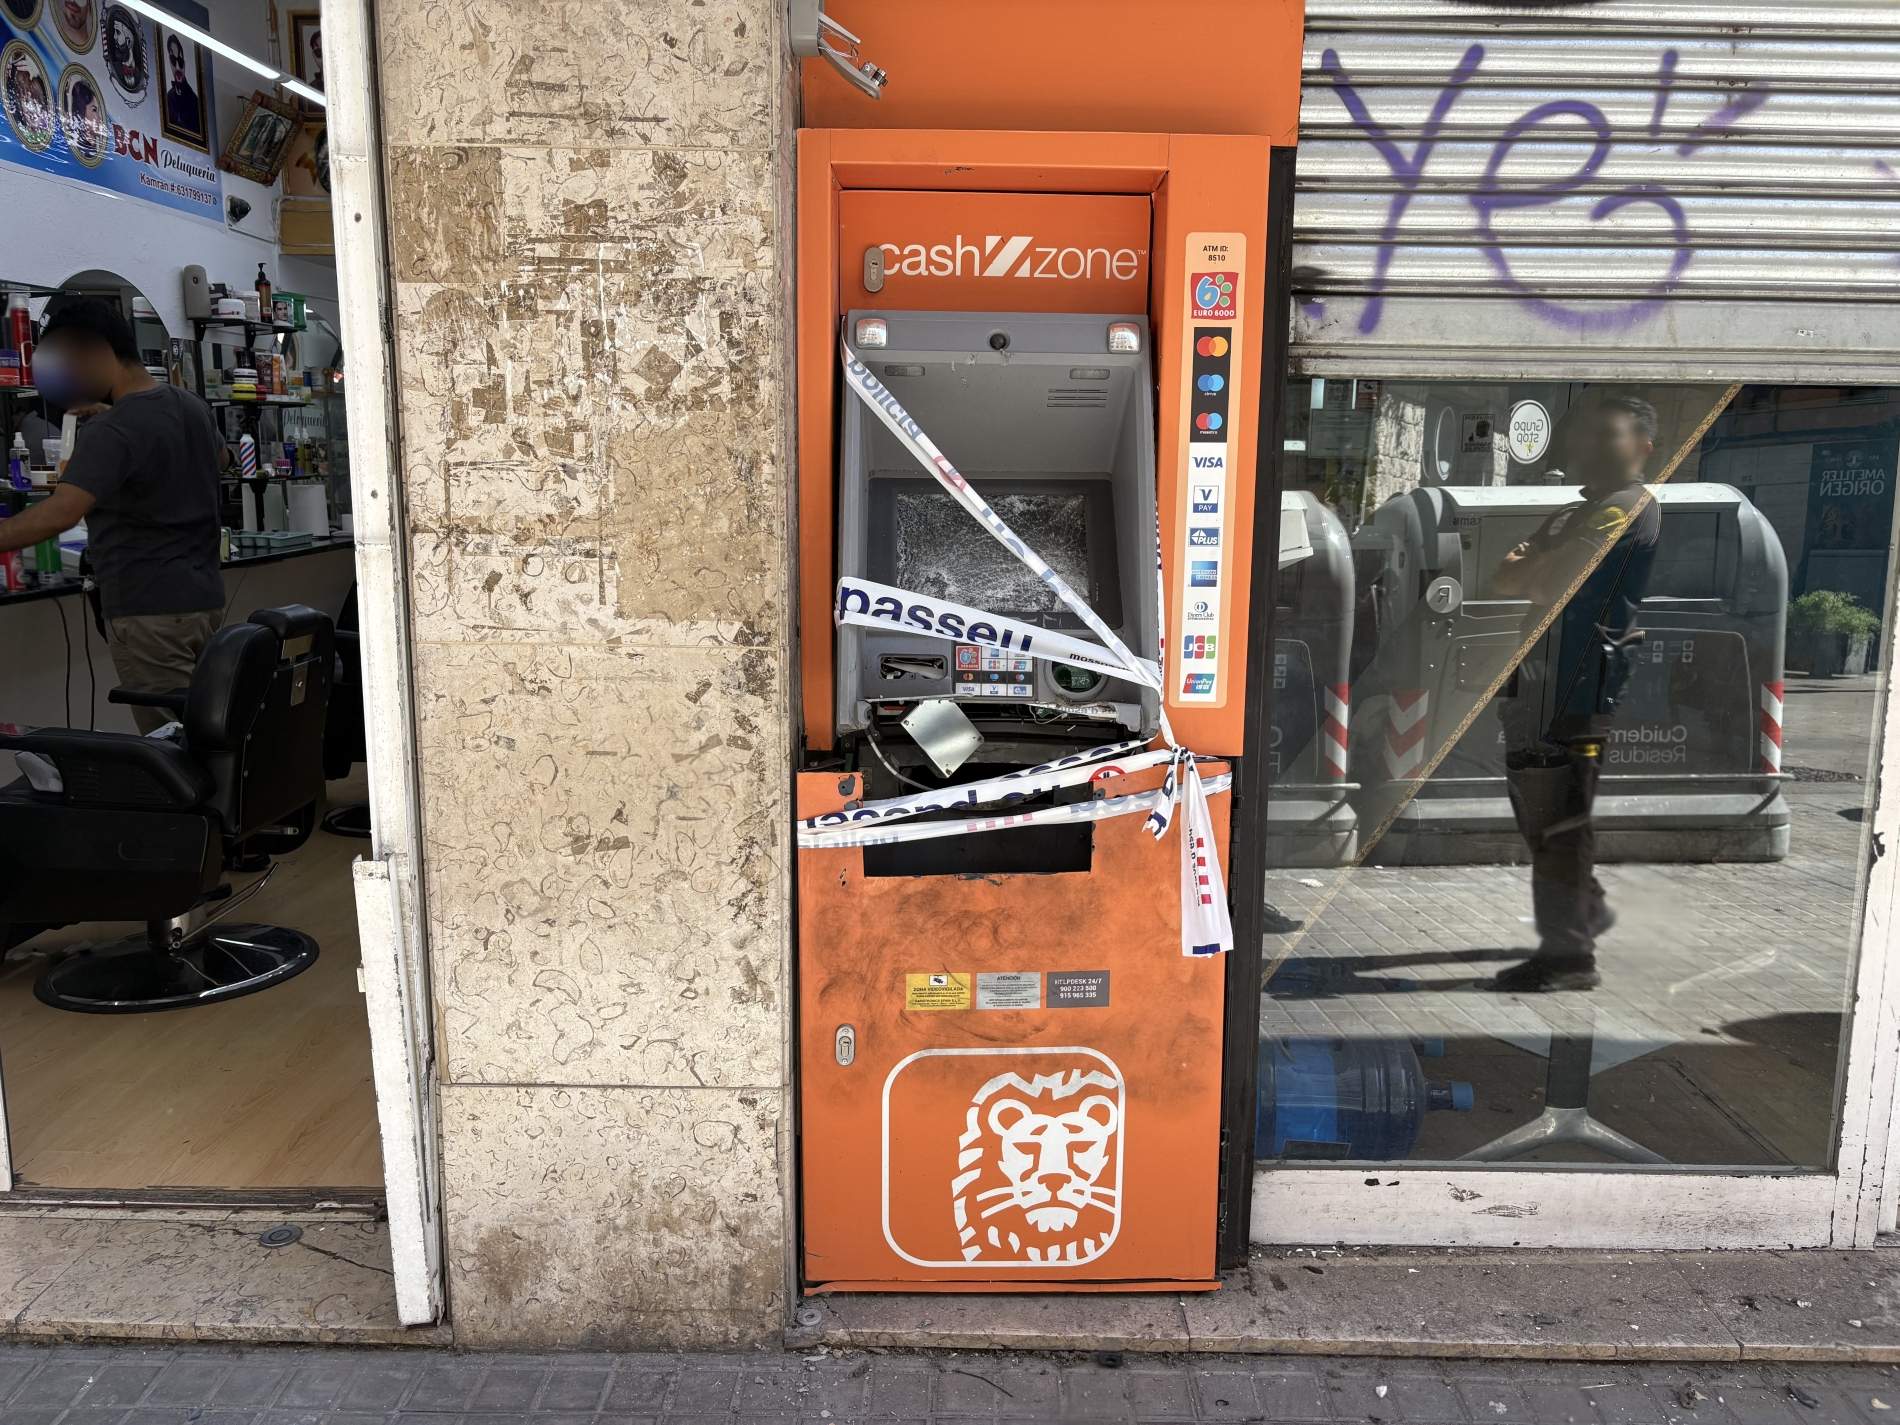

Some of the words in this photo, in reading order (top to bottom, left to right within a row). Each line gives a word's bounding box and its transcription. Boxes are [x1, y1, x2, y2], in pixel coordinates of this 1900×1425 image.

[112, 123, 159, 168] BCN
[161, 149, 216, 183] Peluqueria
[140, 172, 169, 191] Kamran
[878, 234, 980, 277] cash
[1208, 254, 1226, 262] 8510
[1193, 309, 1213, 317] EURO
[1214, 309, 1235, 317] 6000
[1192, 456, 1224, 468] VISA
[1201, 488, 1212, 501] V
[1198, 504, 1213, 512] PAY
[1198, 536, 1218, 545] PLUS
